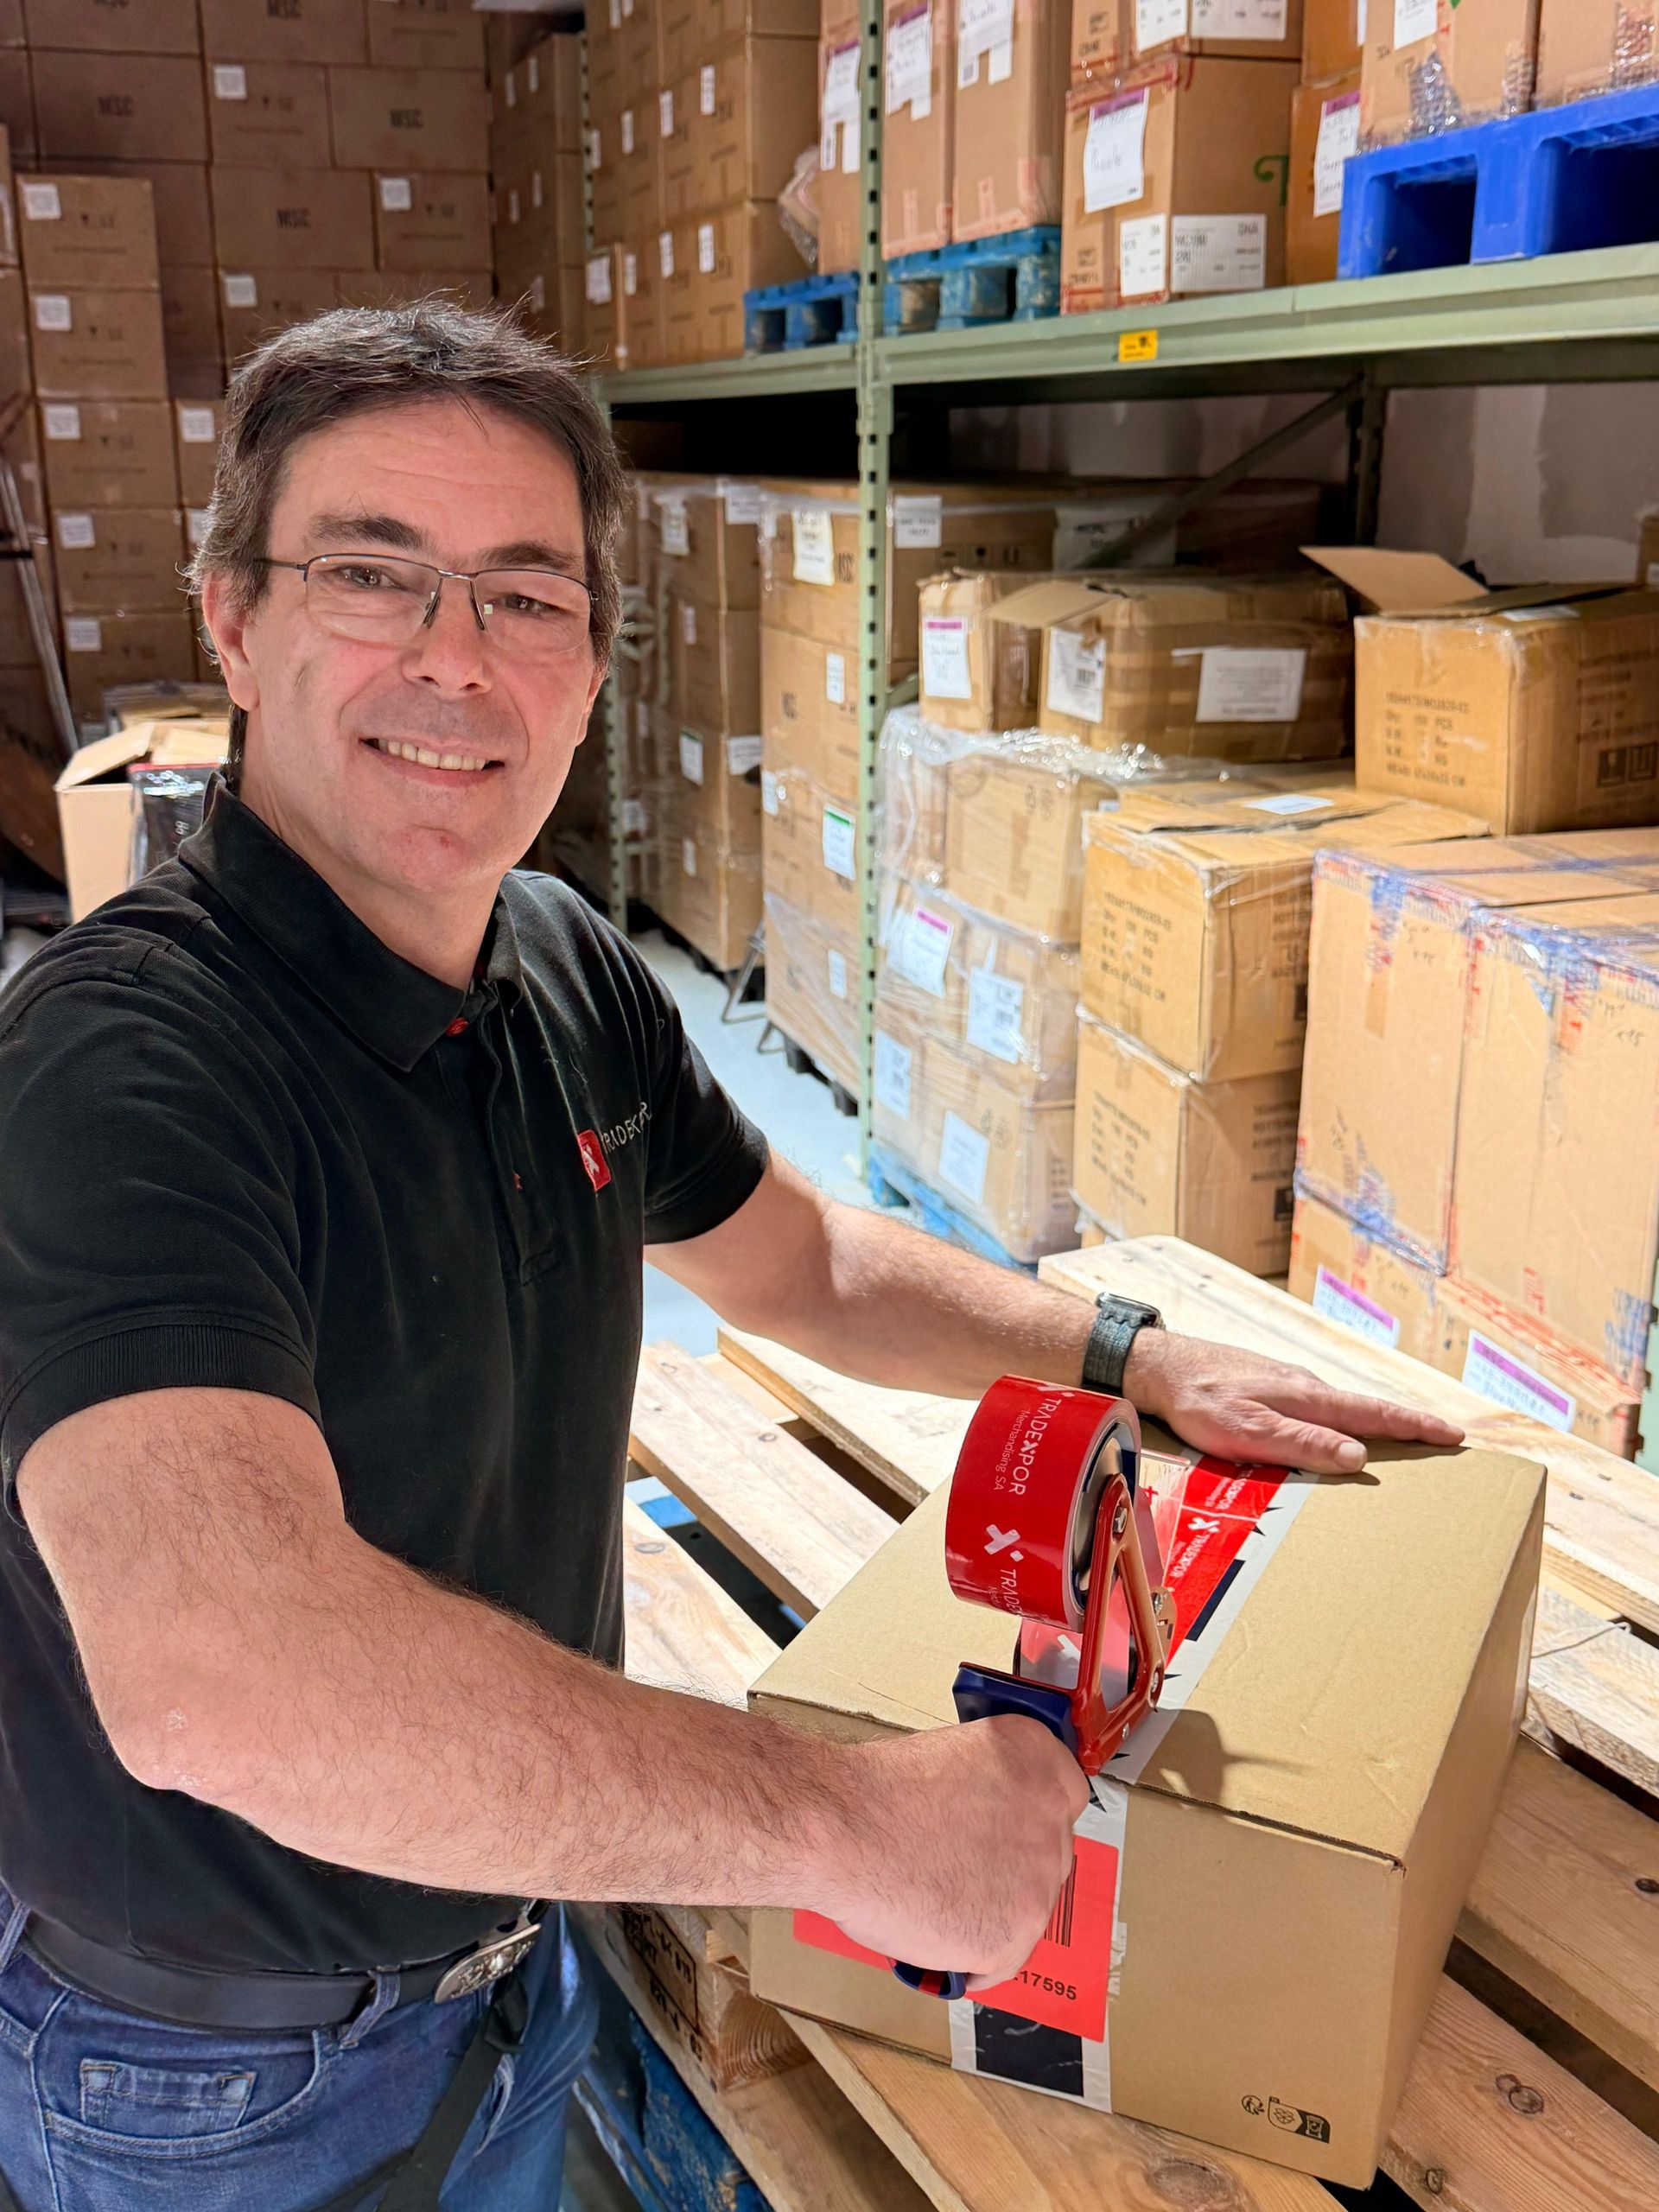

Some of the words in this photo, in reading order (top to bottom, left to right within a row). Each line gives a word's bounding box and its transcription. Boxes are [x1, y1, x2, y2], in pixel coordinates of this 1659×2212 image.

[995, 1408, 1032, 1473] Merchandising
[1007, 1397, 1064, 1496] TRADEXPOR
[993, 1475, 1007, 1491] SA
[1013, 1969, 1077, 2001] 17595
